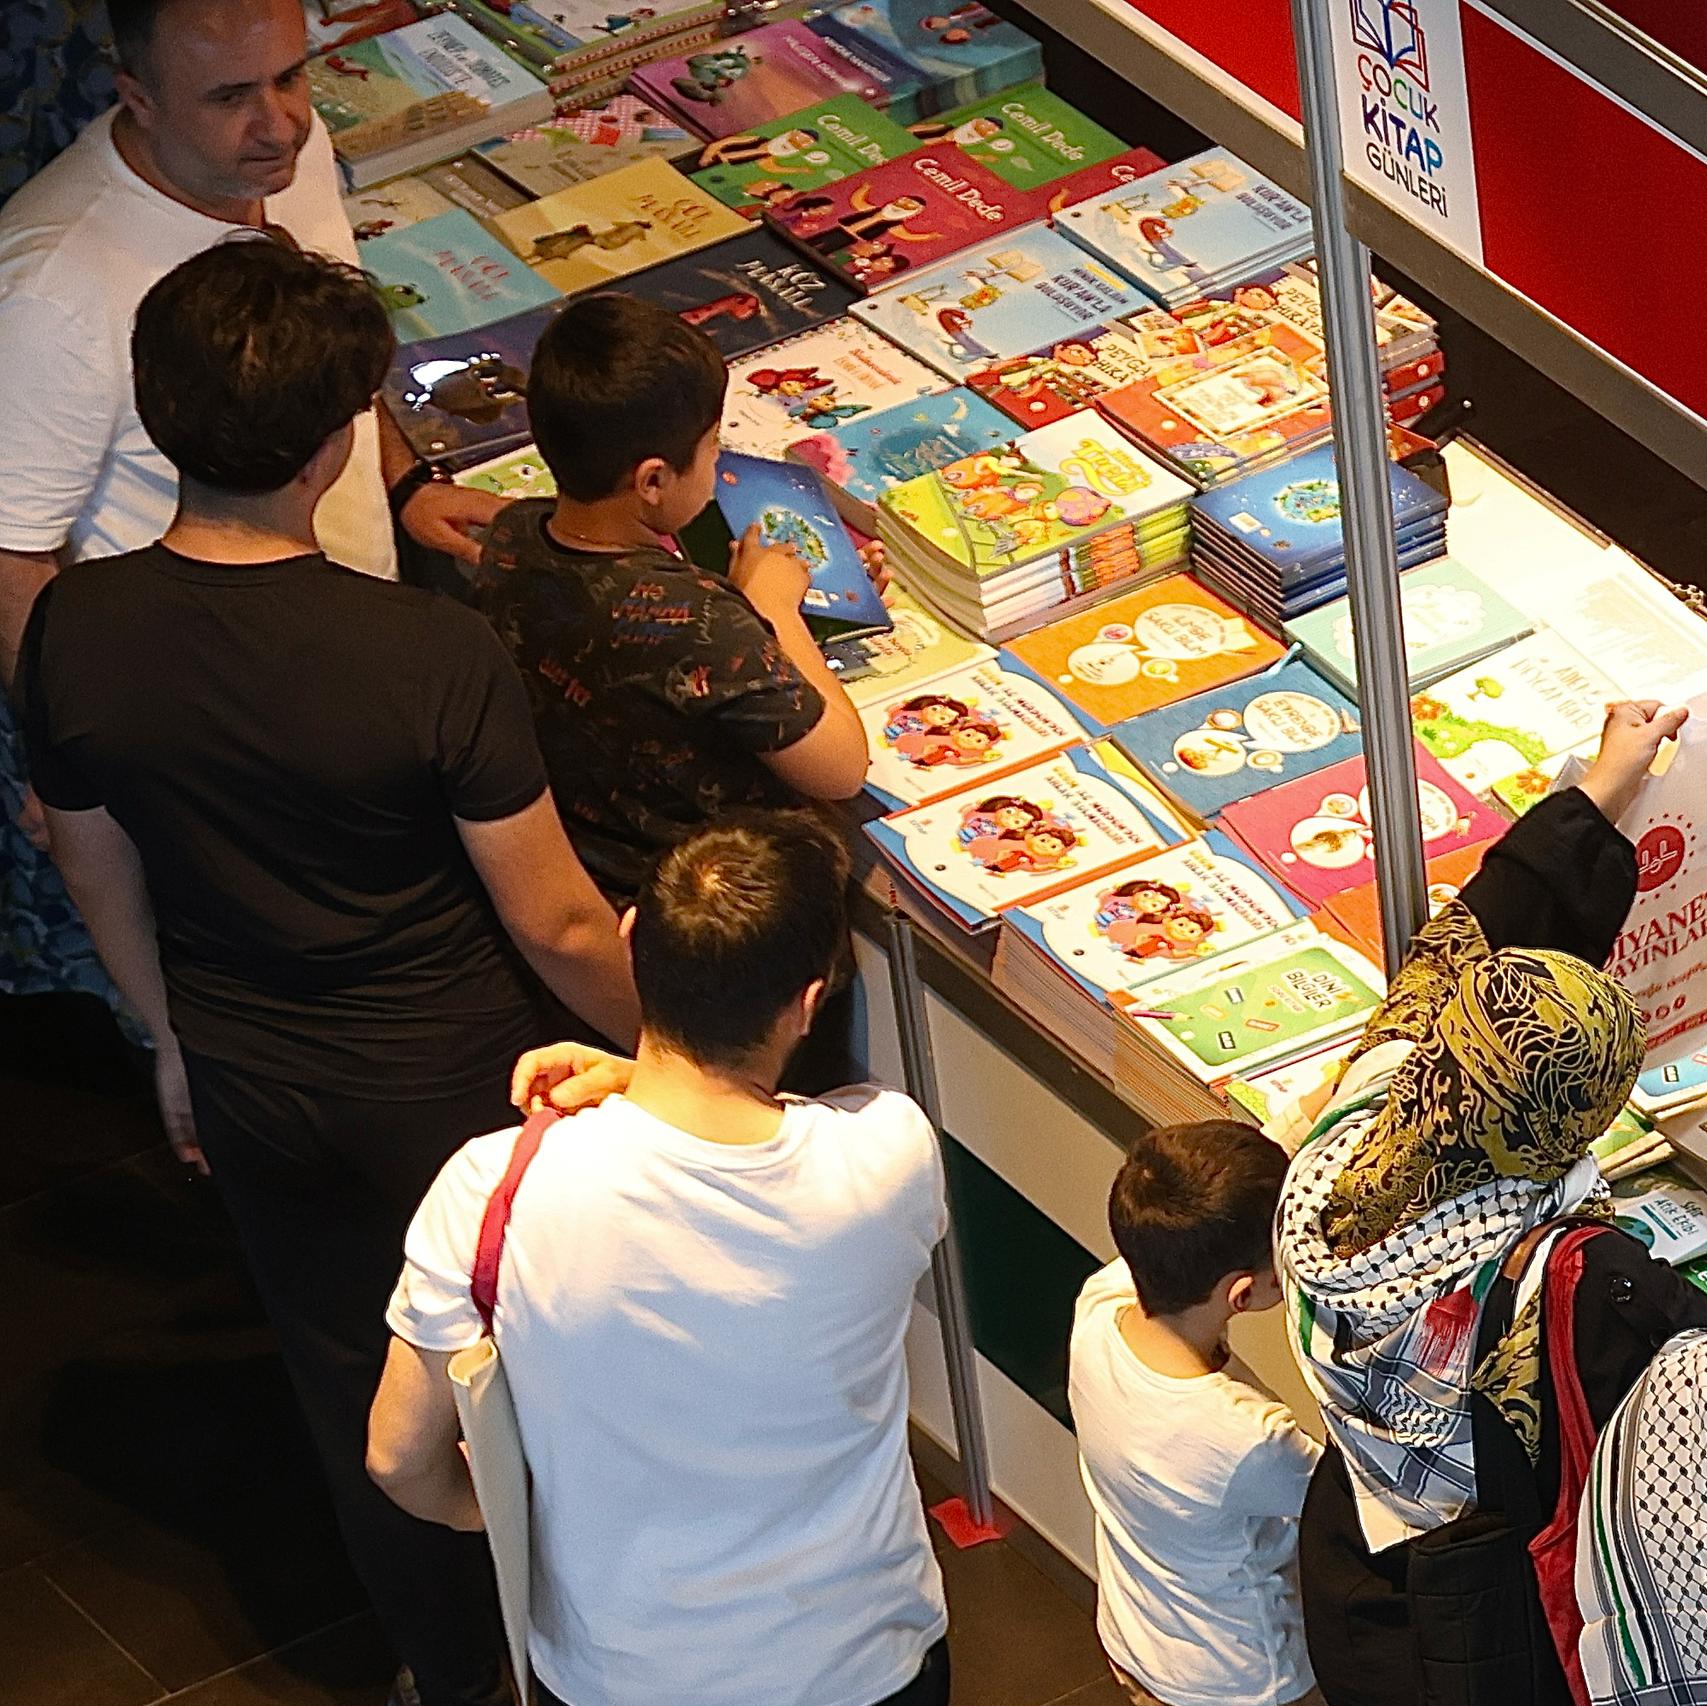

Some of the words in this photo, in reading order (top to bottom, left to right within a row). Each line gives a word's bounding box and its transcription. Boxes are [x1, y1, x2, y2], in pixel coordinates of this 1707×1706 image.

[1002, 103, 1044, 137] Cemil
[1042, 127, 1085, 161] Dede
[1358, 55, 1438, 133] ÇOCUK
[1362, 95, 1443, 178] KİTAP
[912, 158, 961, 196] Cemil
[957, 180, 1005, 221] Dede
[1366, 141, 1448, 217] GÜNLERİ
